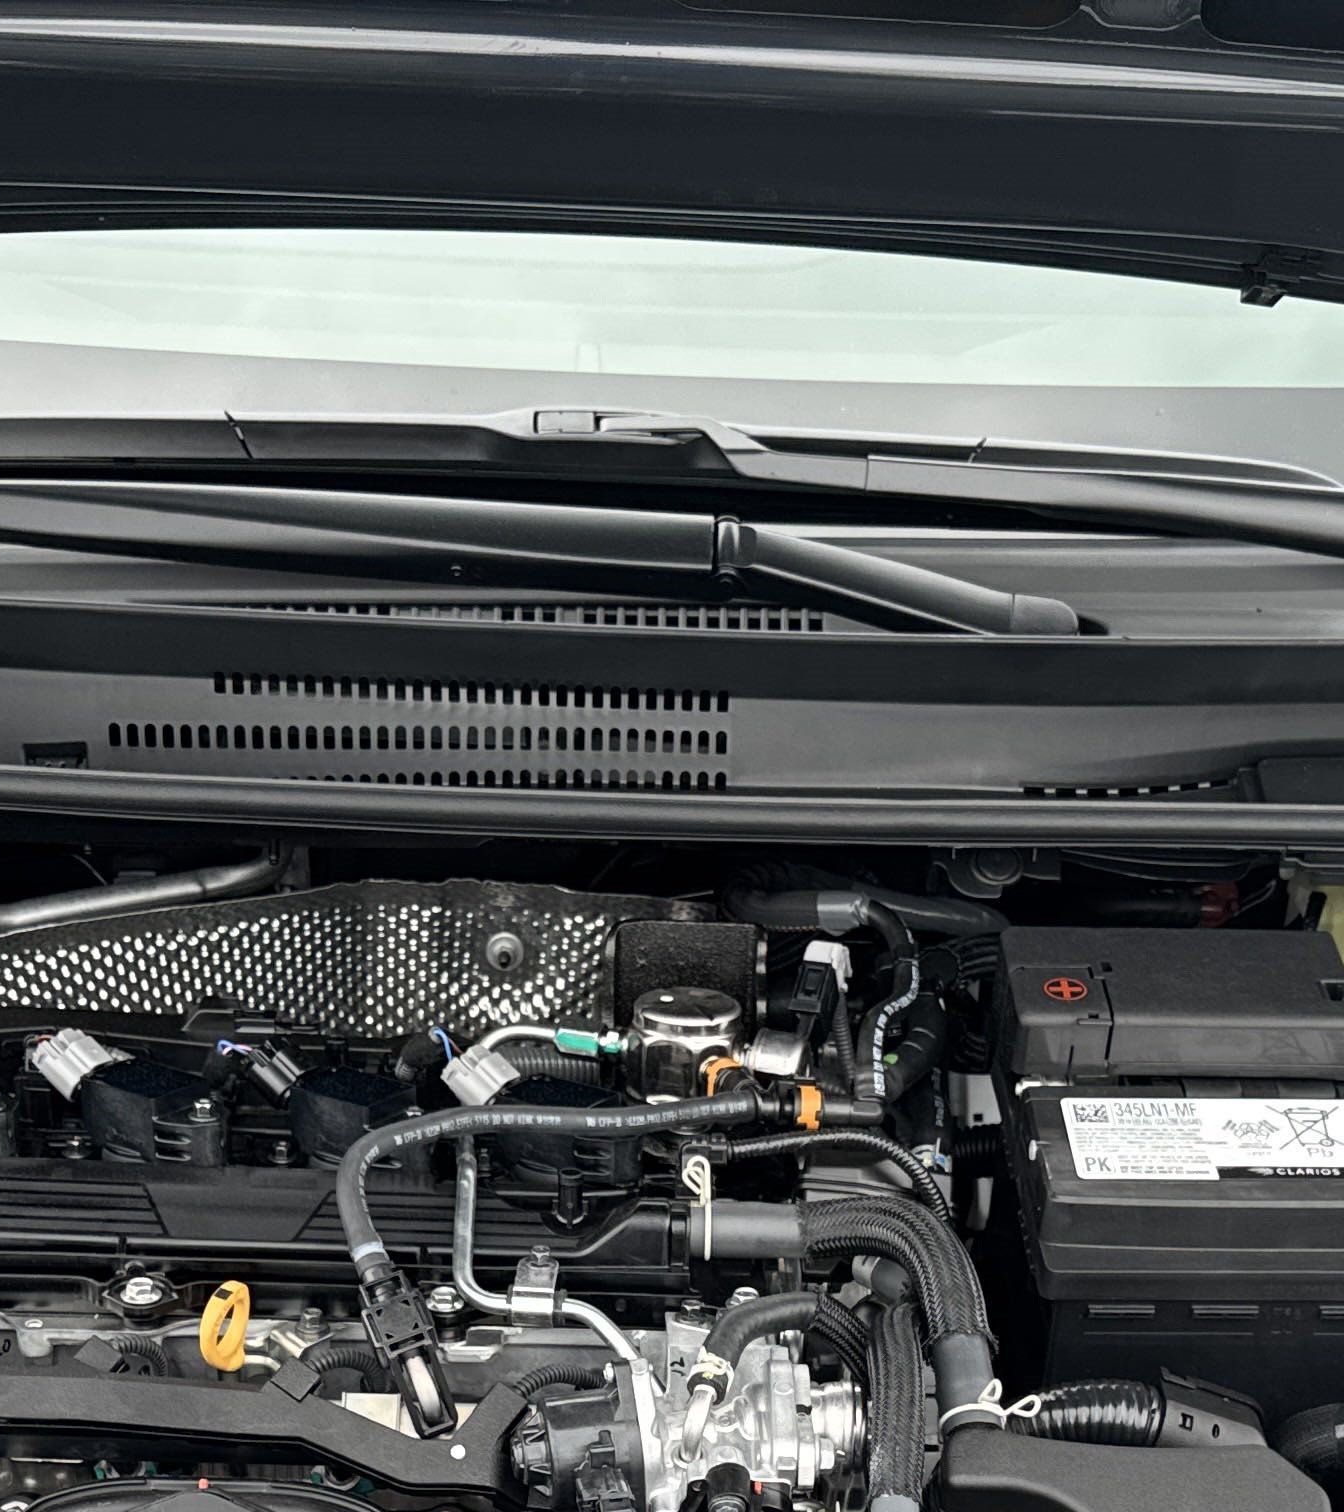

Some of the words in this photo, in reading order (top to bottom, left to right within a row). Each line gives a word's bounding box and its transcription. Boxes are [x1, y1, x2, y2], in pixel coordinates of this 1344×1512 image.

[1113, 1103, 1197, 1117] 345LN1-MF
[1085, 1157, 1111, 1172] PK
[1276, 1168, 1341, 1176] CLARIOS
